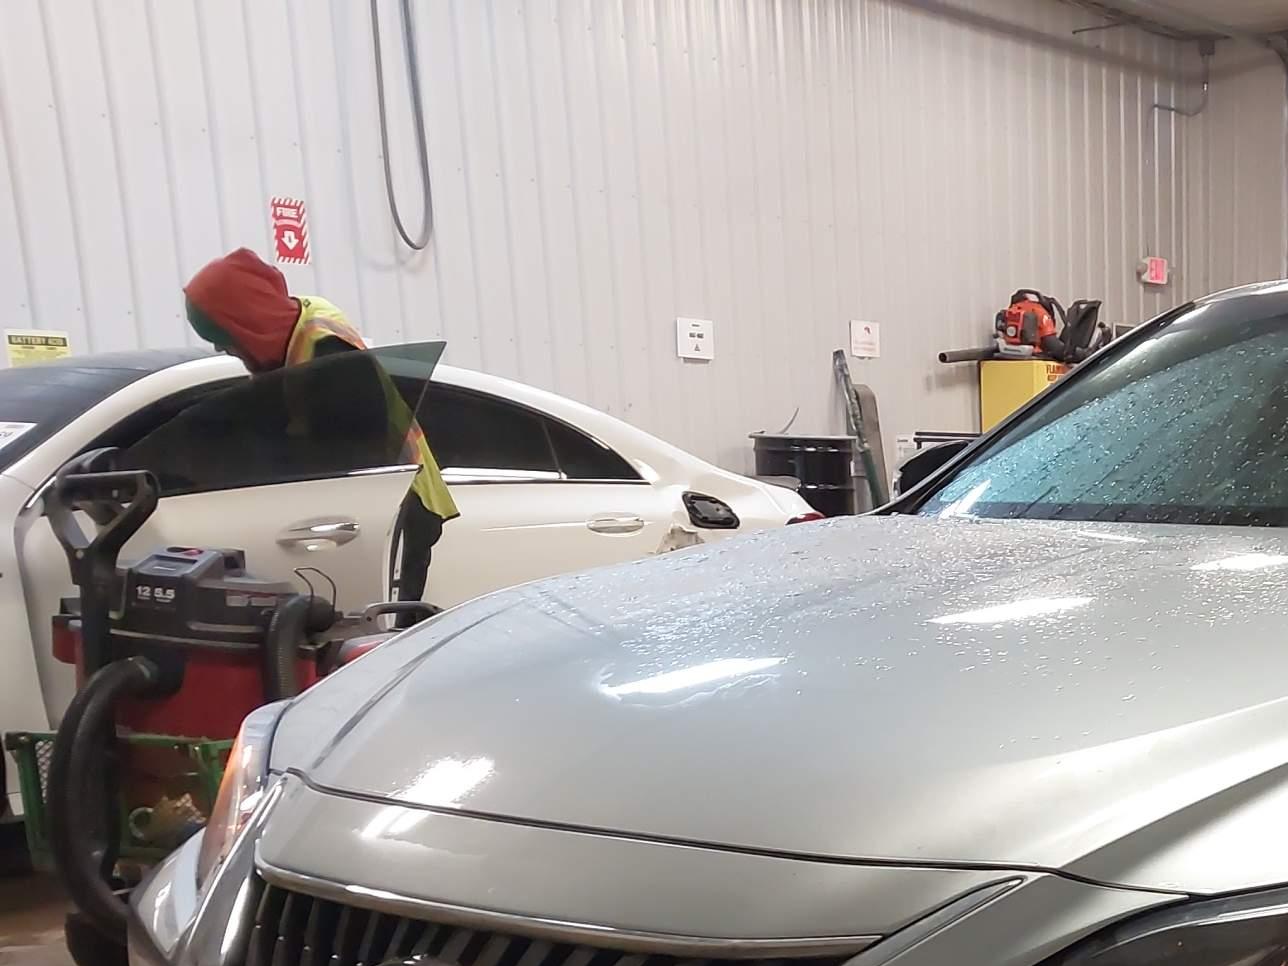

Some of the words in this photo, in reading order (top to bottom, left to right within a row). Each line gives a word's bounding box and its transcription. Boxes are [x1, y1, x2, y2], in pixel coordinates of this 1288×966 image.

[276, 206, 298, 218] FIRE
[10, 335, 46, 345] BATTERY
[136, 585, 151, 597] 12
[154, 588, 175, 599] 5.5
